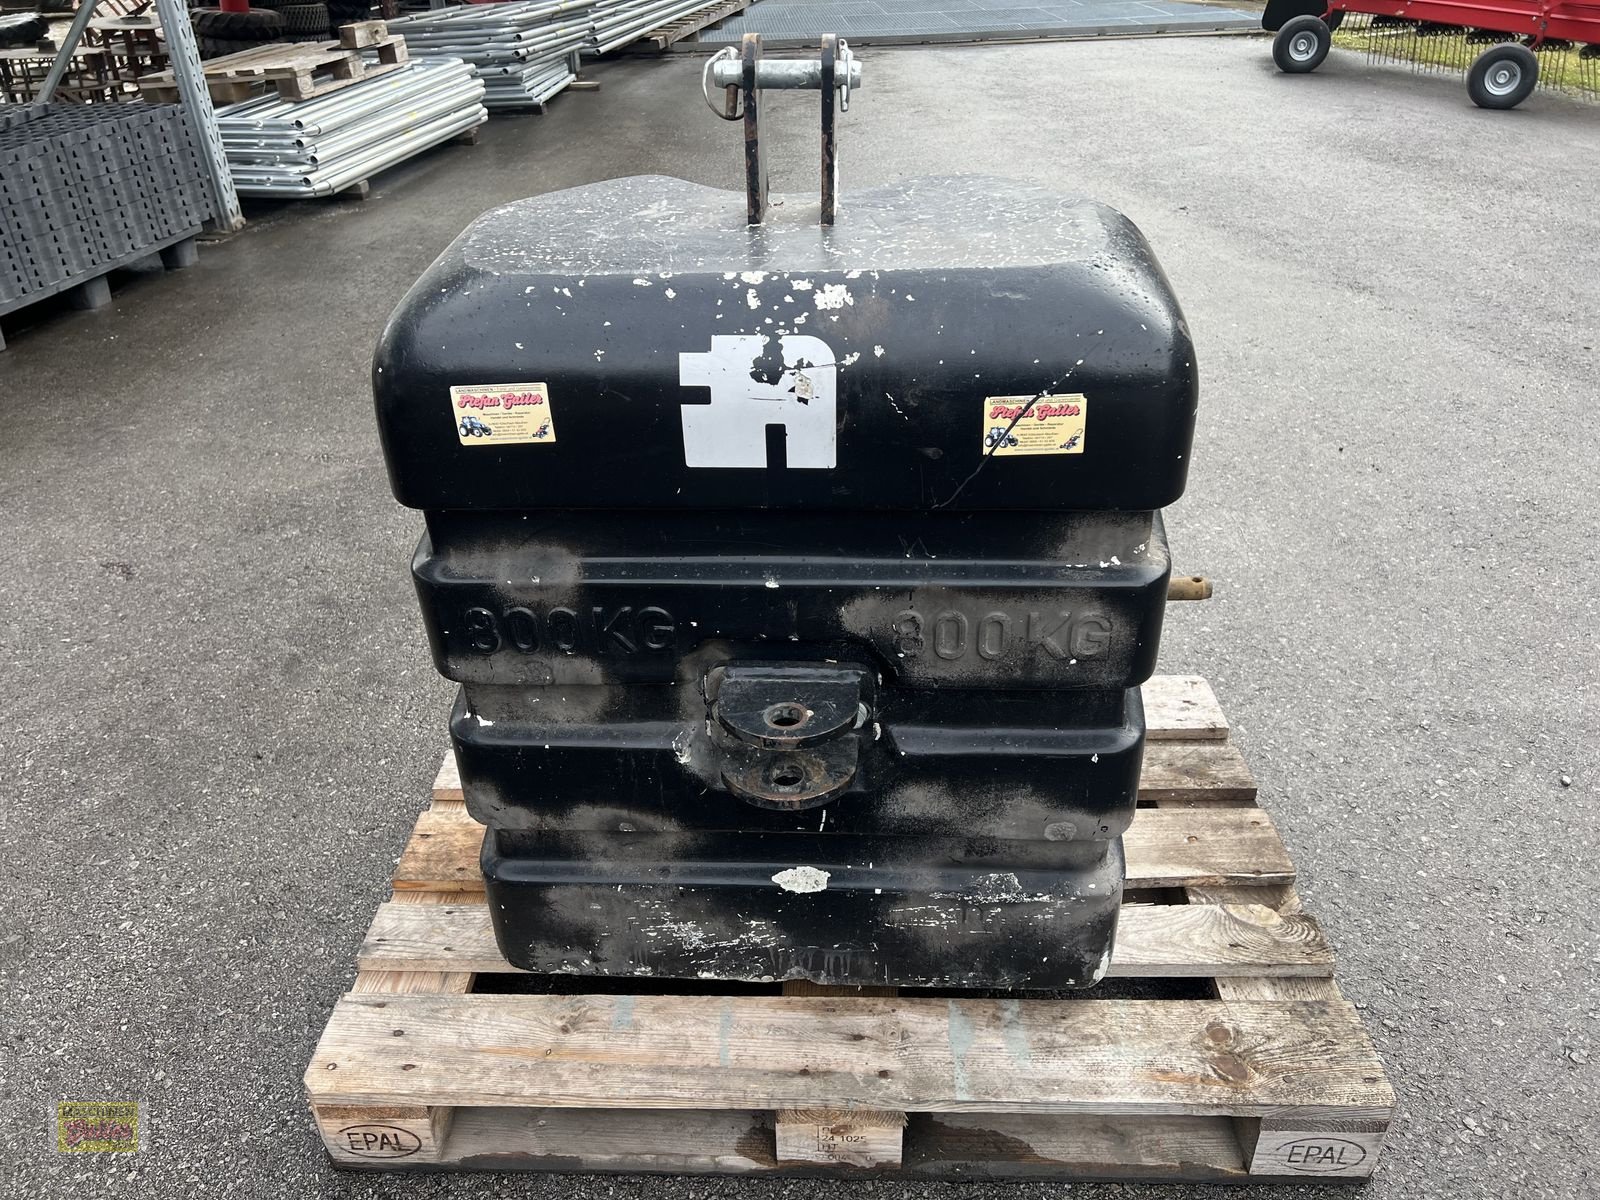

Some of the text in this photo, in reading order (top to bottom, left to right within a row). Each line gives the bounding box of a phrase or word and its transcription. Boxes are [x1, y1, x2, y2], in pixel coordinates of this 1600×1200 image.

[501, 391, 544, 410] Gailer
[1036, 403, 1081, 421] Gailer
[592, 606, 677, 654] KG
[1027, 611, 1113, 661] KG
[346, 1132, 413, 1152] EPAL
[1286, 1145, 1348, 1165] EPAL
